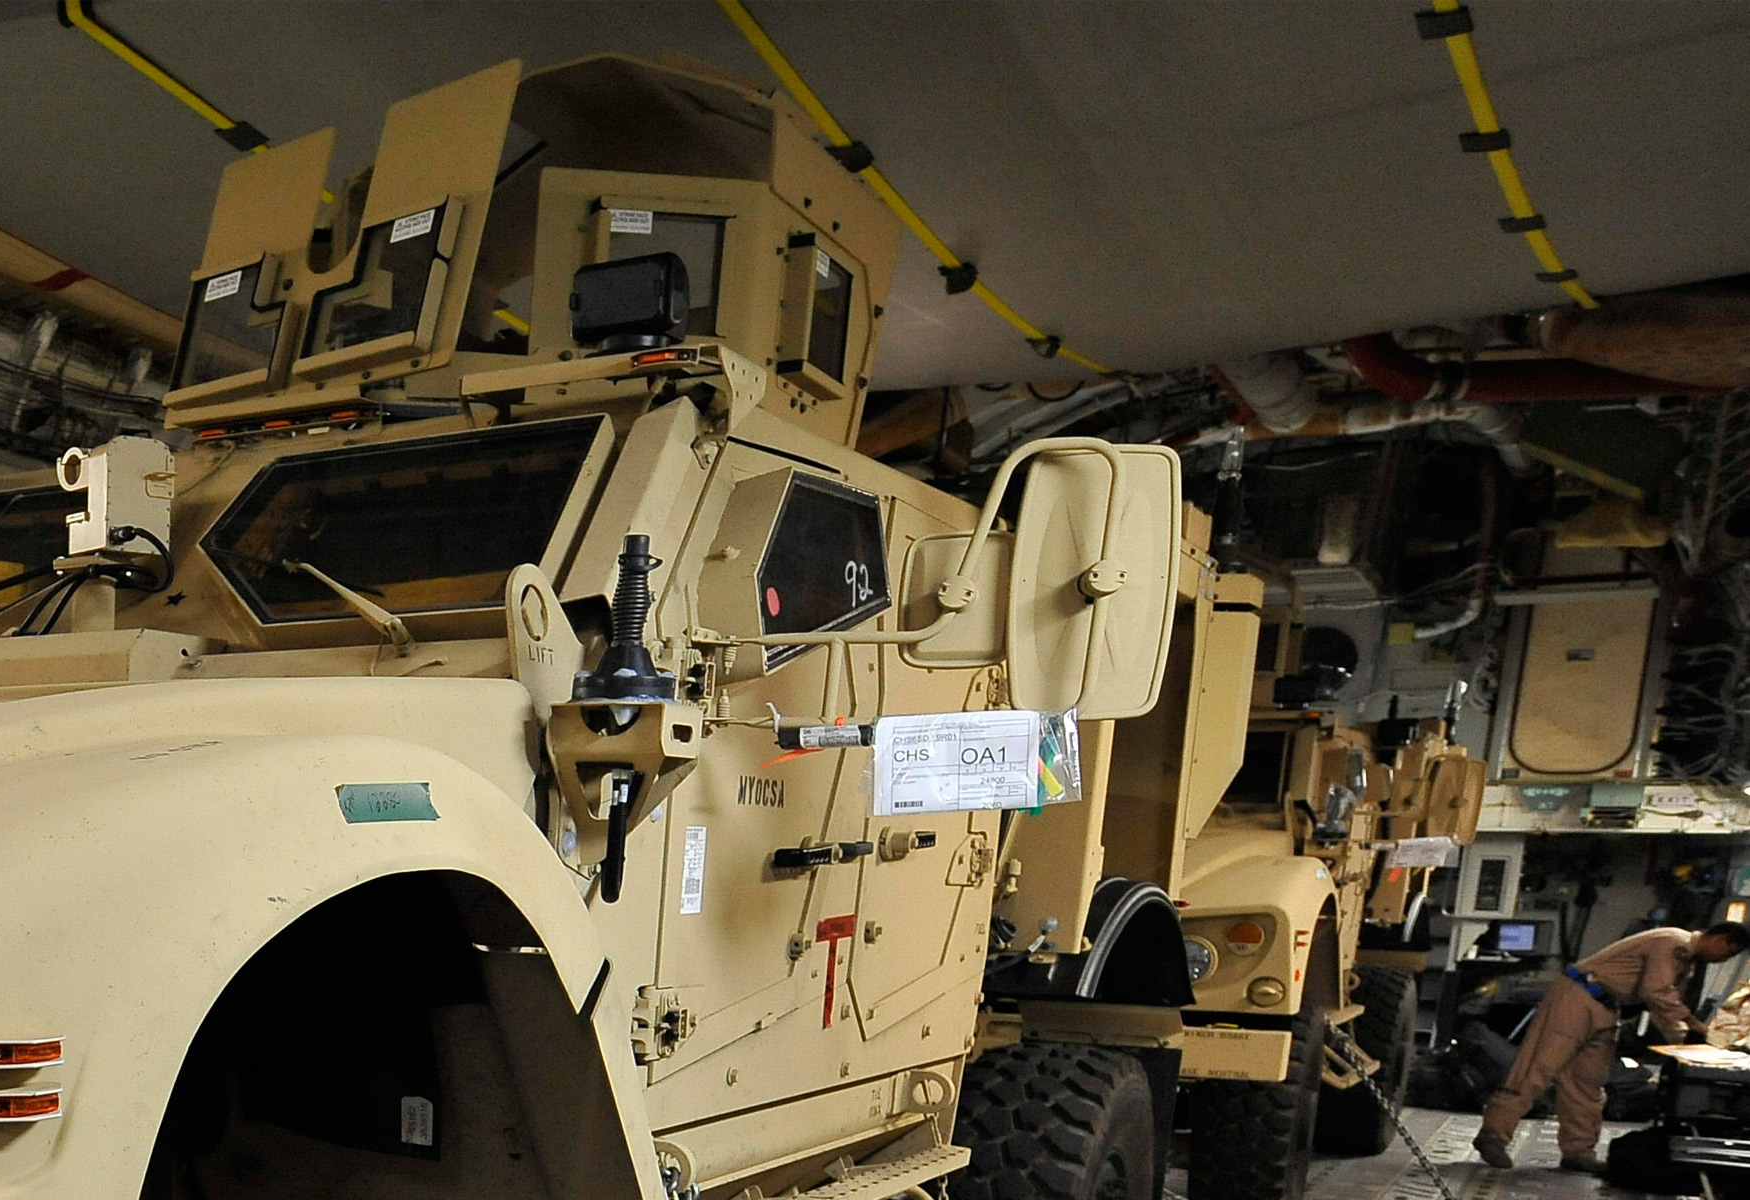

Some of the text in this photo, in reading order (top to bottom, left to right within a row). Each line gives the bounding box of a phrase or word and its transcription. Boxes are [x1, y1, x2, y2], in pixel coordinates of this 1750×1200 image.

[845, 560, 874, 608] 92
[528, 644, 554, 666] LIFT
[893, 746, 1006, 765] CHS OA1
